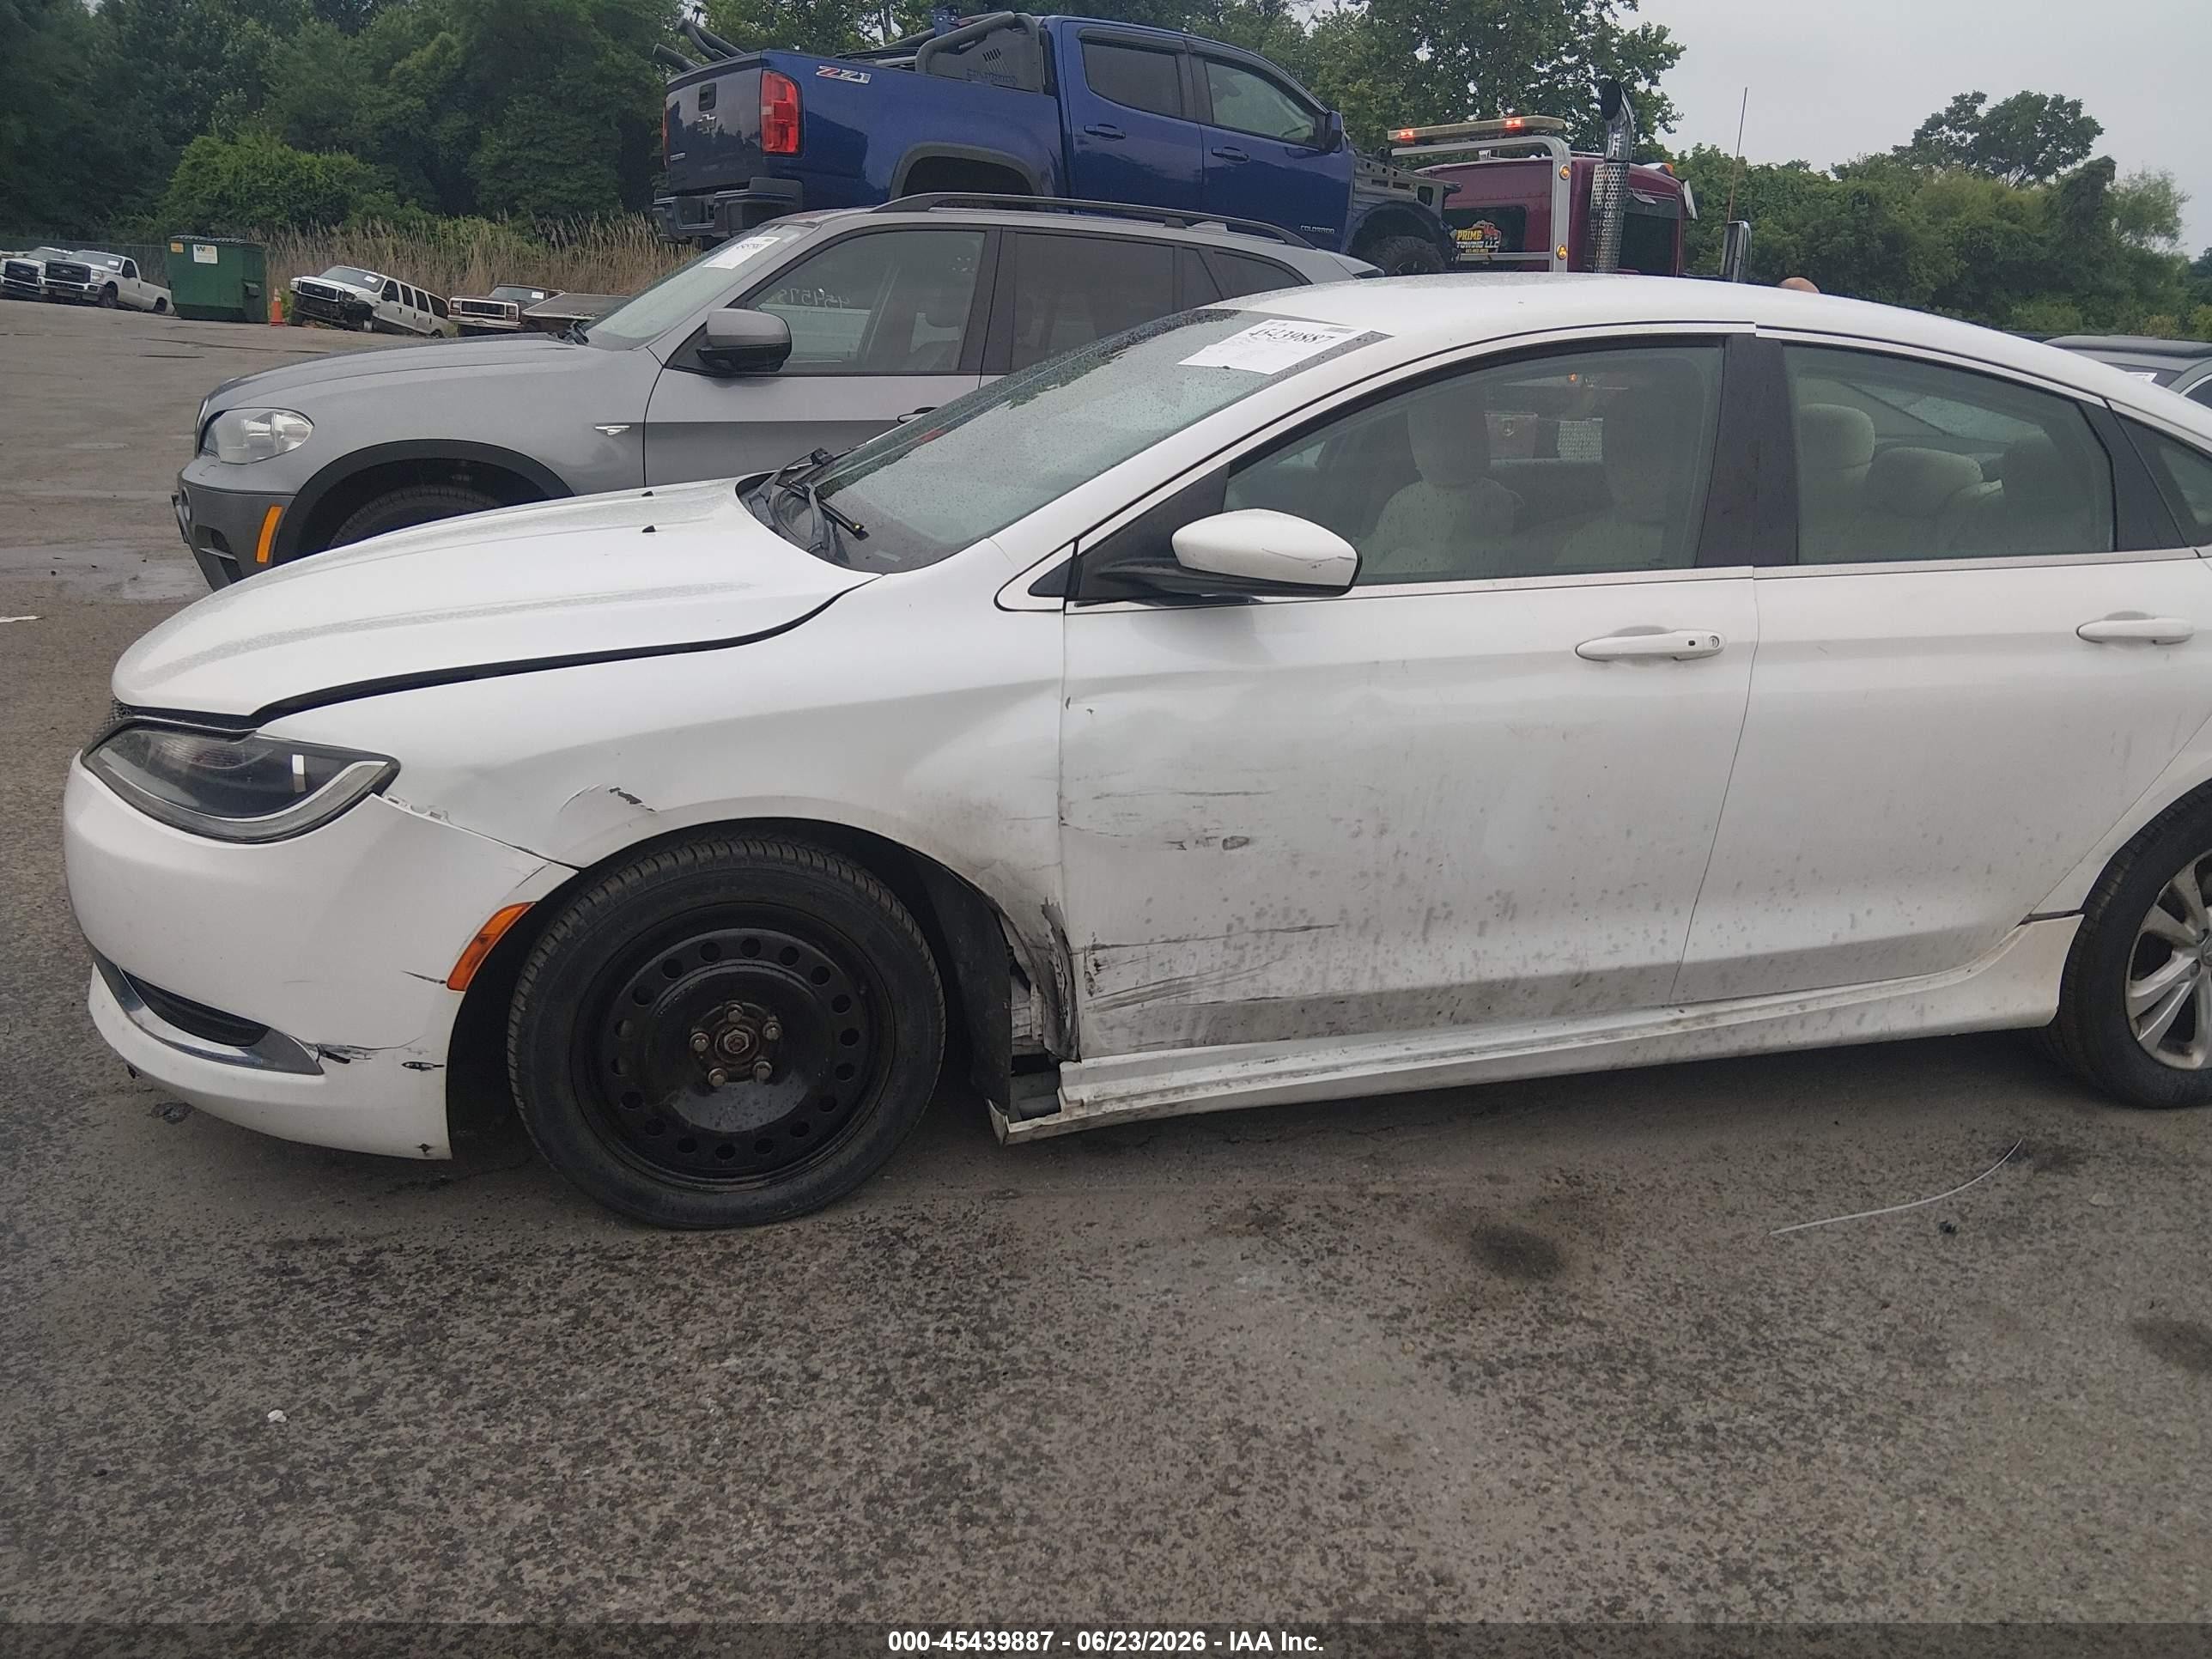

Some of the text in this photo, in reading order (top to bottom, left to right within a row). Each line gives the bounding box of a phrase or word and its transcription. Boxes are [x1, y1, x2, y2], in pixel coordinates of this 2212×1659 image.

[816, 65, 872, 84] Z71
[1457, 229, 1483, 240] PRIME
[1456, 240, 1484, 249] TOWING
